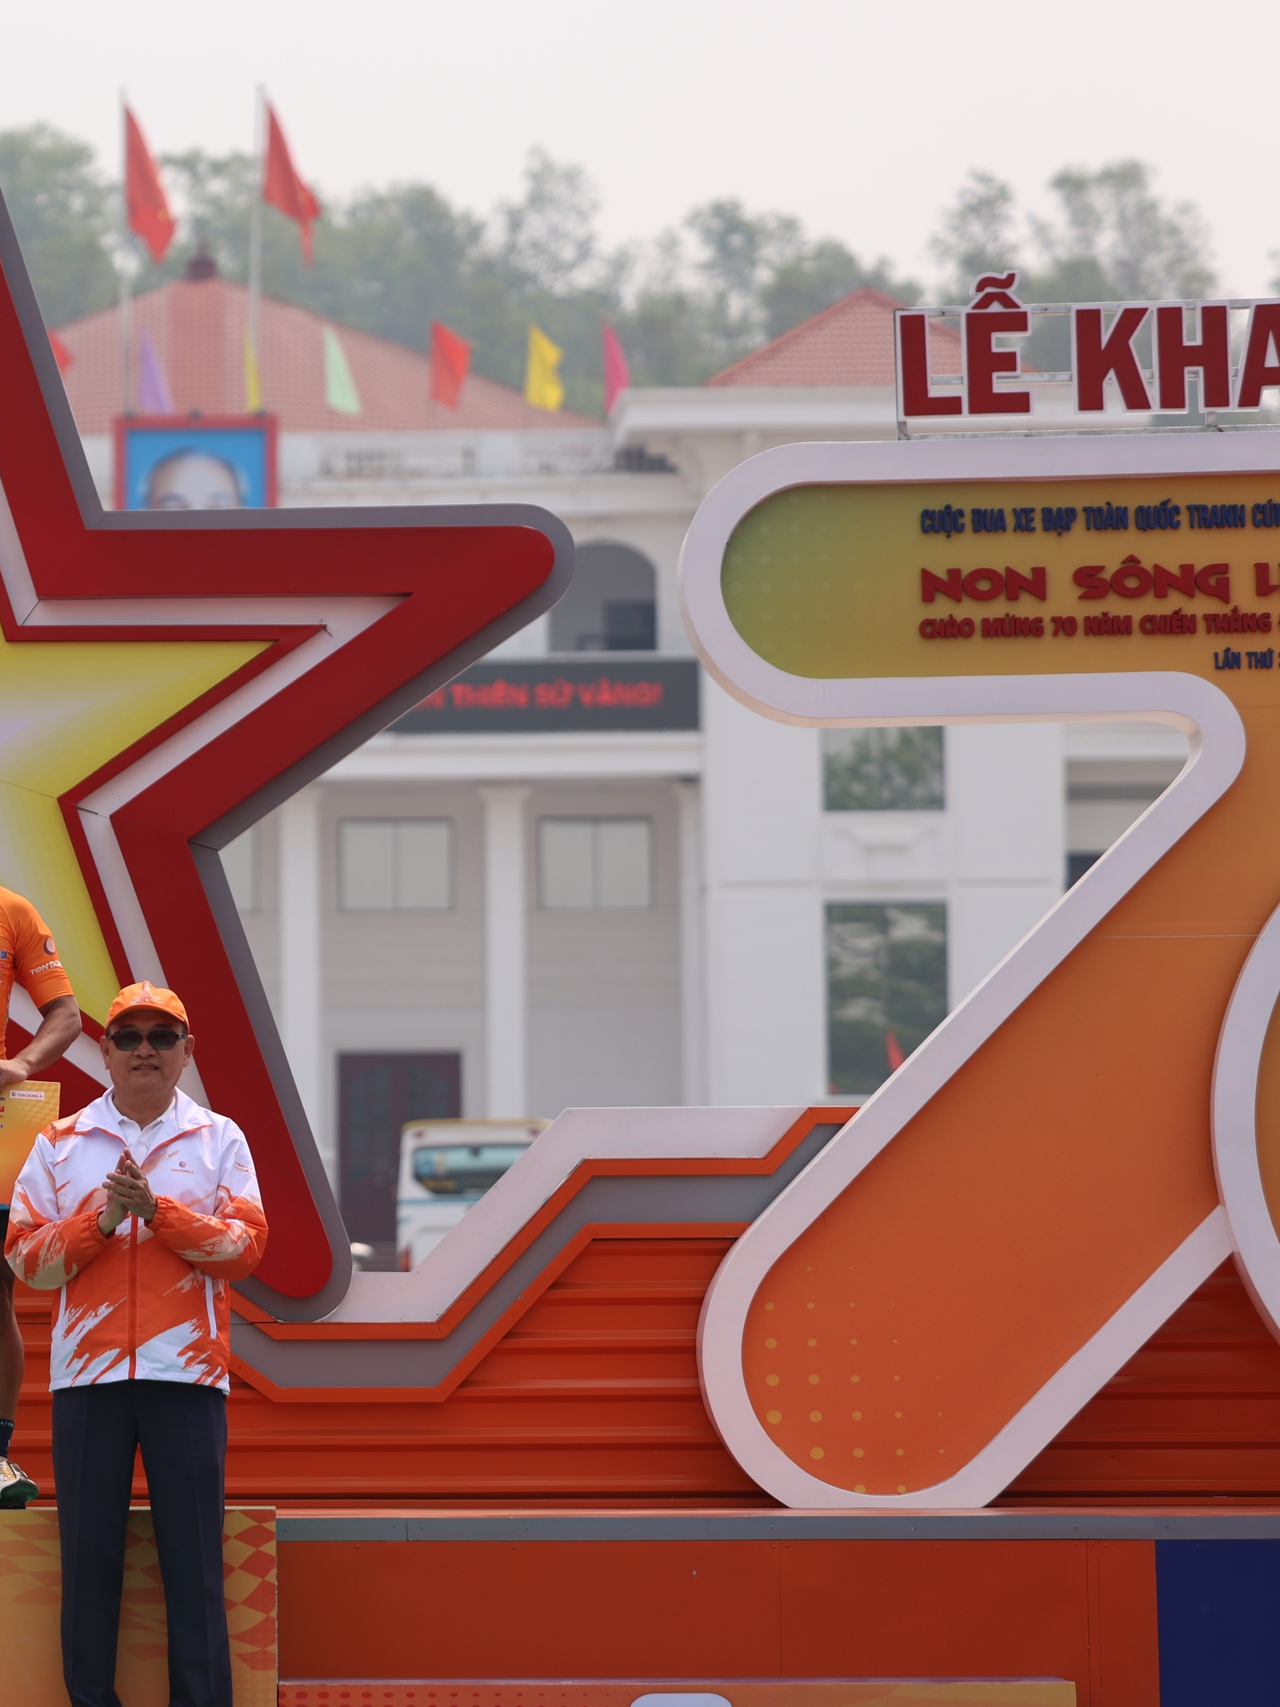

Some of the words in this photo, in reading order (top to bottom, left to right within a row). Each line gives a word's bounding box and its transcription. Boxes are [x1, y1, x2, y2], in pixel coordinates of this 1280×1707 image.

[899, 271, 1031, 417] LỄ
[920, 504, 966, 538] CUỘC
[971, 508, 1007, 532] ĐUA
[1012, 507, 1036, 532] XE
[1041, 507, 1078, 537] ĐẠP
[1082, 501, 1128, 531] TOÀN
[1134, 498, 1181, 531] QUỐC
[1186, 504, 1246, 529] TRANH
[921, 565, 1047, 603] NON
[1072, 553, 1230, 604] SÔNG
[919, 613, 975, 639] CHÀO
[1050, 616, 1078, 637] 70
[1084, 611, 1133, 635] NĂM
[1139, 607, 1197, 635] CHIẾN
[1246, 647, 1274, 669] THỨ
